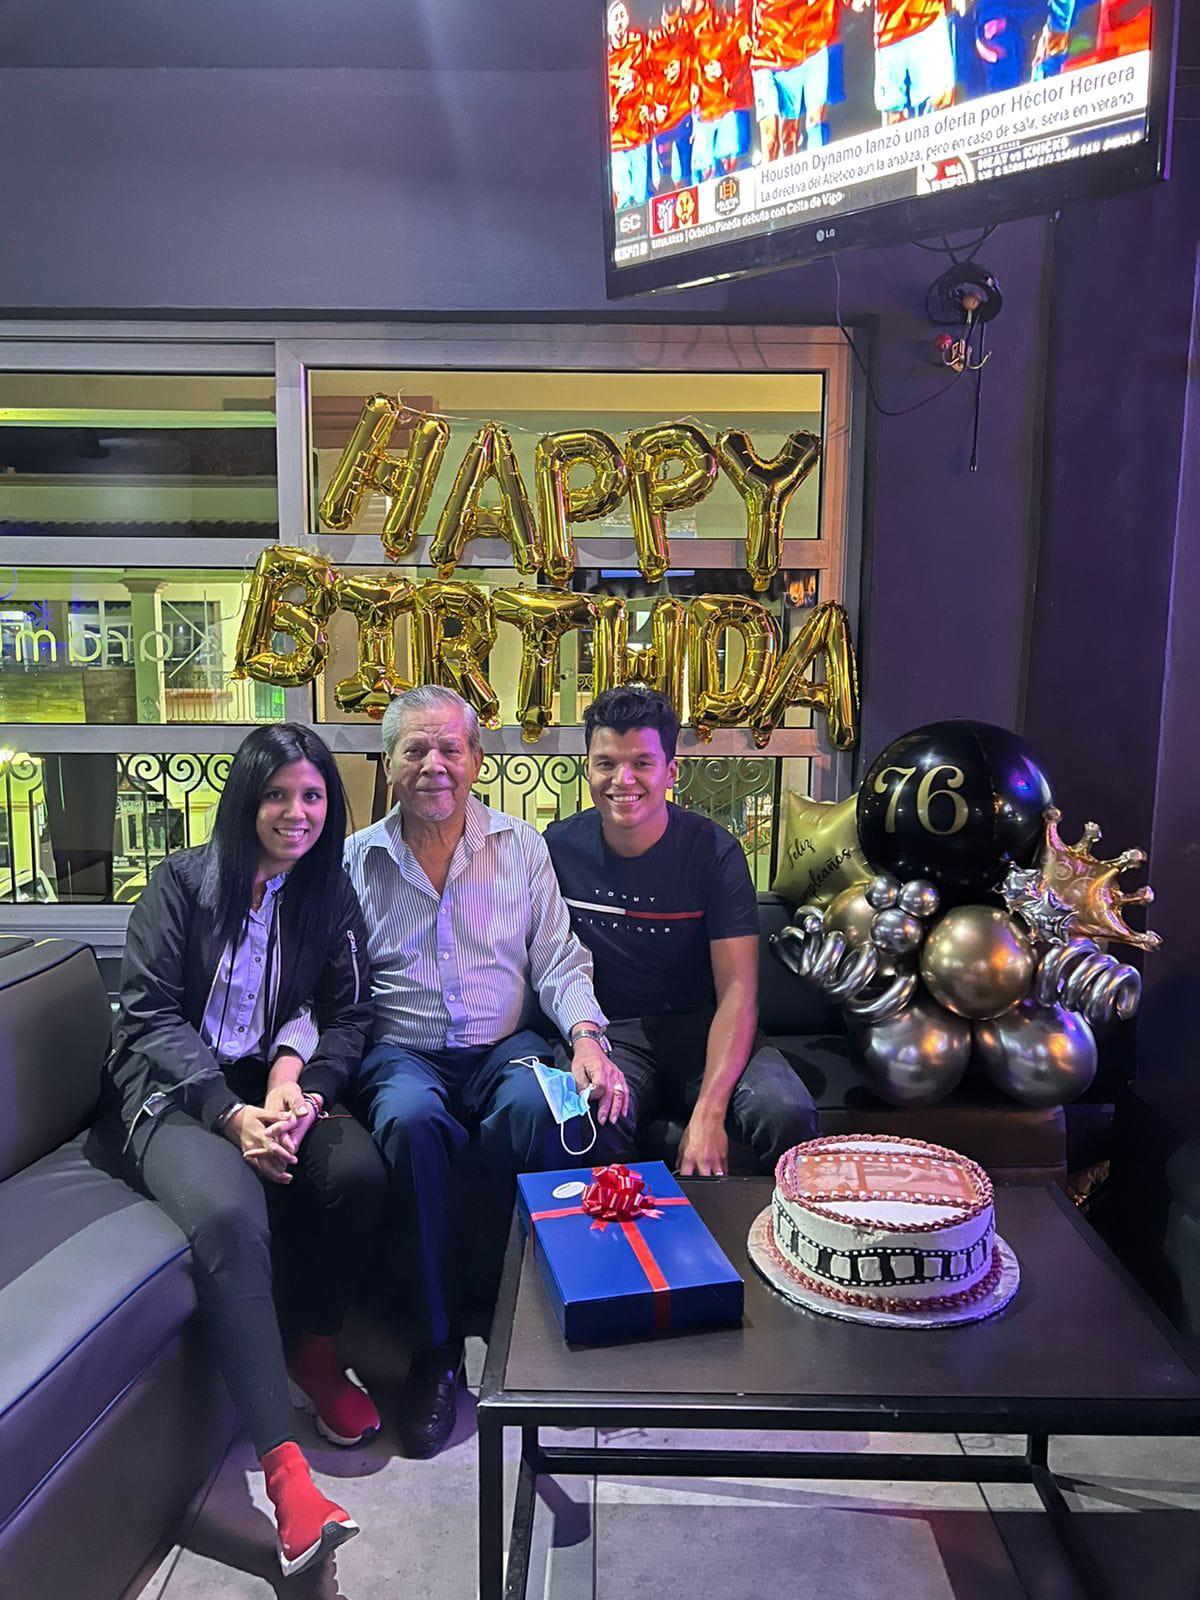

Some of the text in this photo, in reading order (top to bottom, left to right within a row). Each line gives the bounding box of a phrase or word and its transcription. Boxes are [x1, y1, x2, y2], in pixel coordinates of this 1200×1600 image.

[760, 190, 773, 203] La
[808, 177, 821, 191] del
[876, 157, 886, 170] la
[926, 141, 950, 161] pero
[952, 138, 965, 151] en
[968, 130, 993, 147] caso
[996, 124, 1010, 139] de
[1073, 104, 1089, 118] en
[1092, 92, 1134, 113] verano
[761, 66, 1135, 185] Houston Dynamo lanzó una oferta por Héctor Herrera
[770, 207, 786, 219] con
[787, 200, 810, 215] Celta
[810, 196, 821, 209] de
[821, 191, 843, 206] Vigo
[319, 392, 822, 591] HAPPY
[231, 544, 860, 752] BIRTHDA
[874, 765, 969, 836] 76
